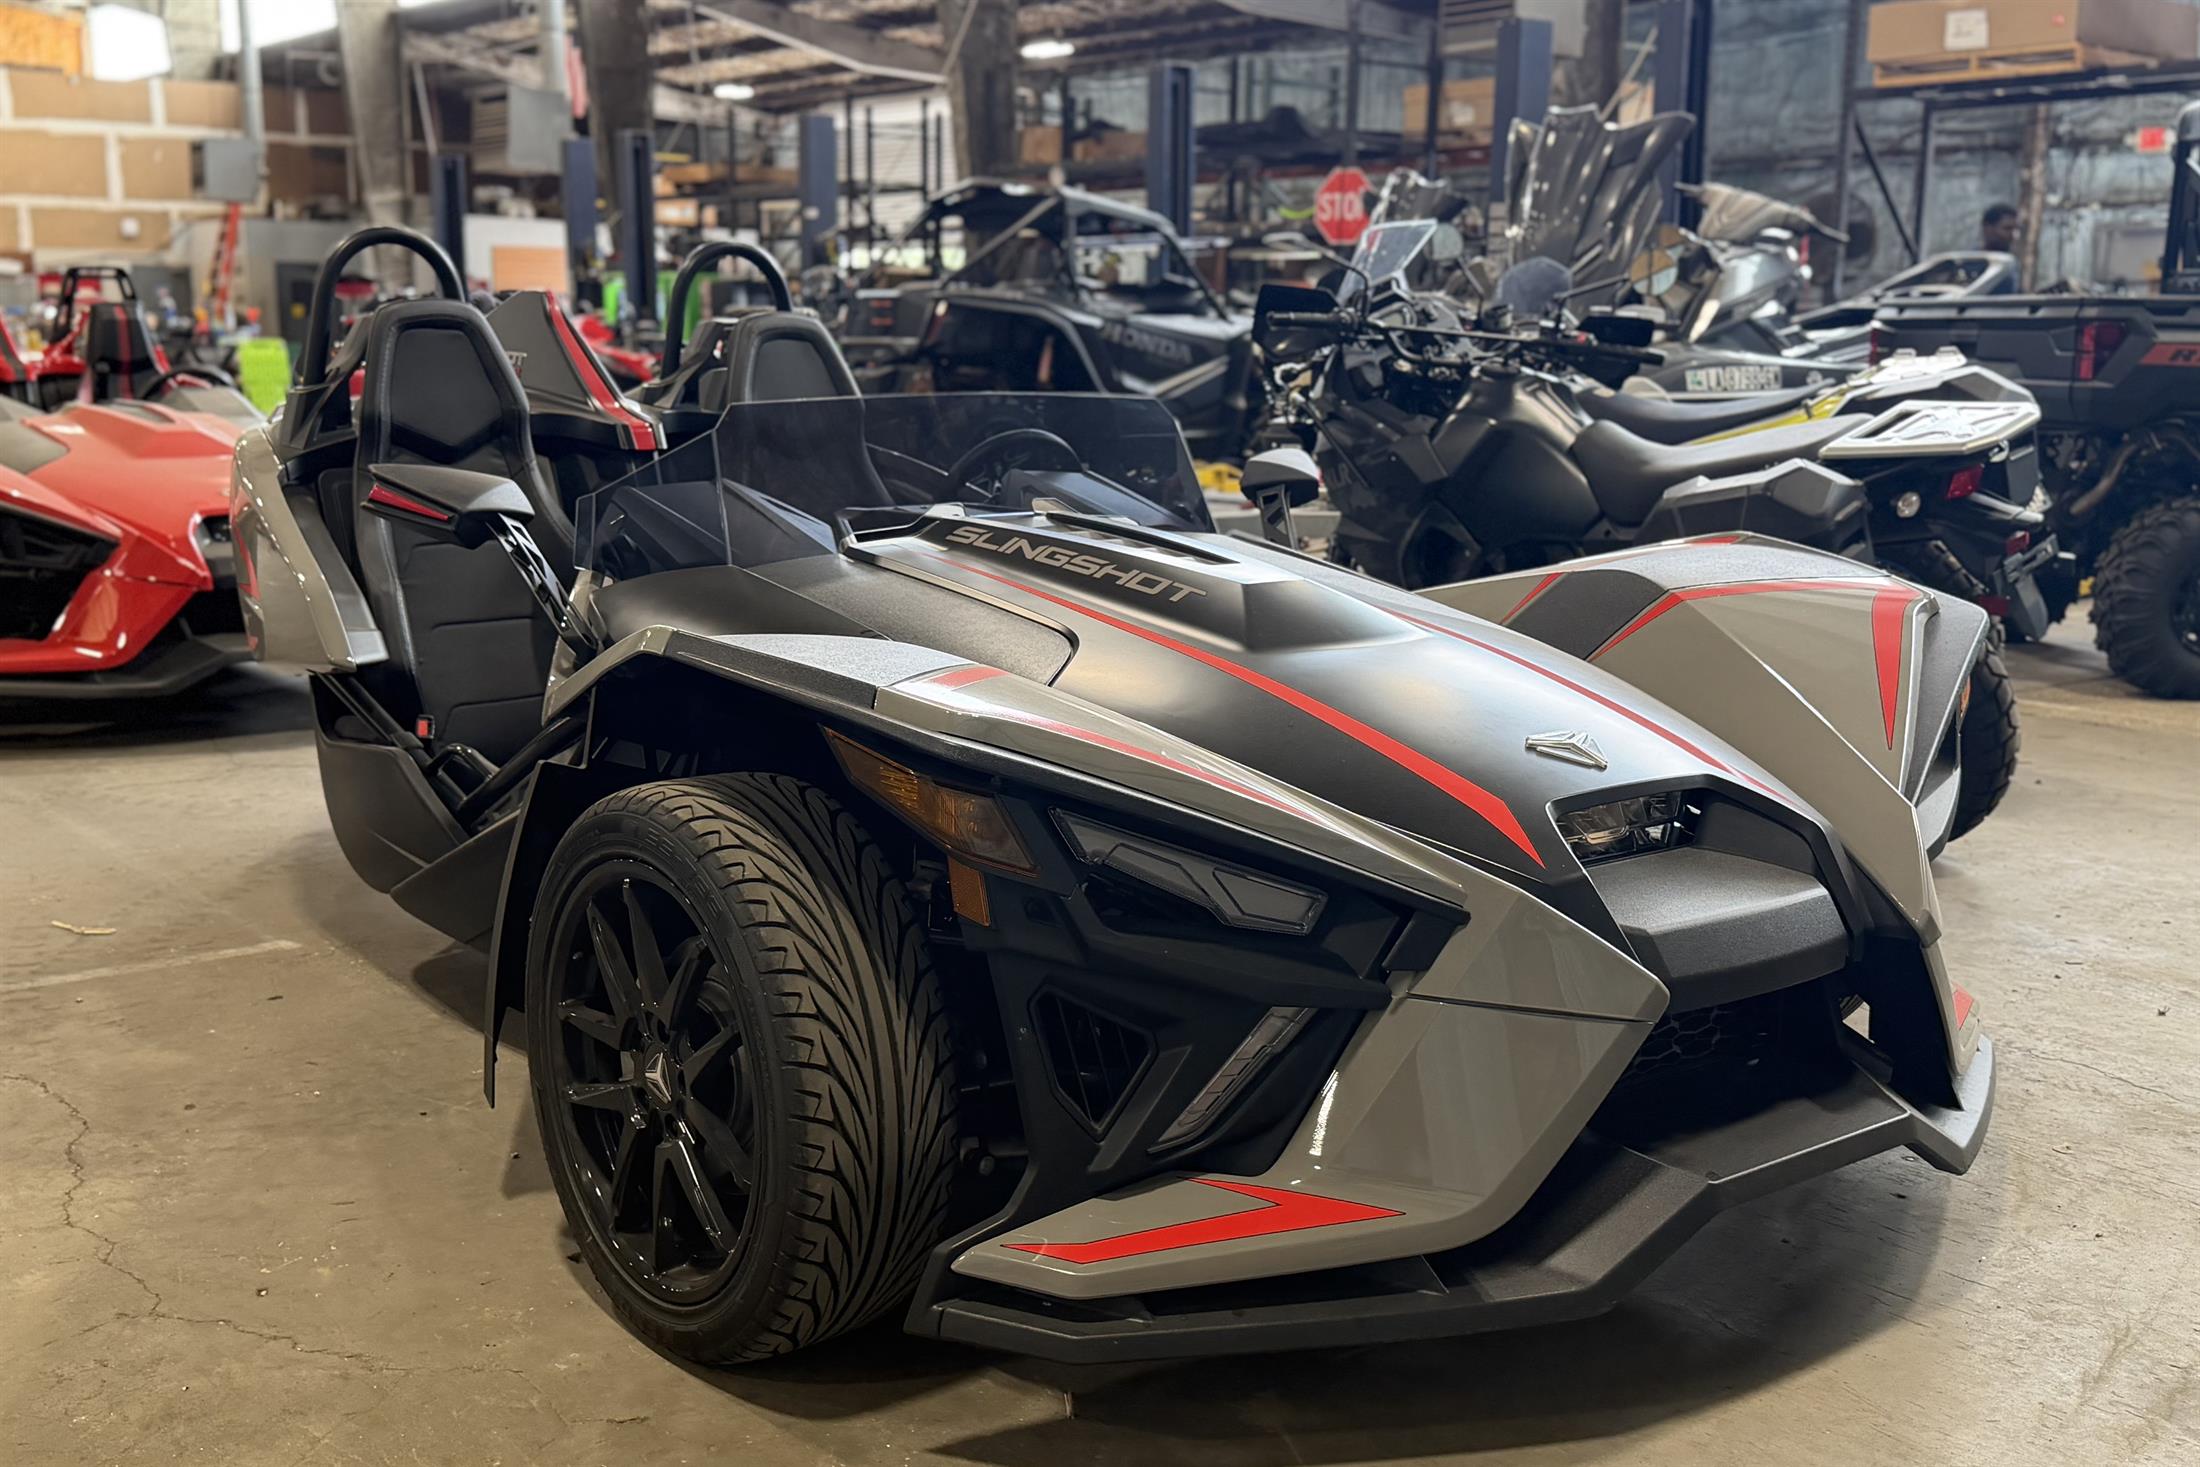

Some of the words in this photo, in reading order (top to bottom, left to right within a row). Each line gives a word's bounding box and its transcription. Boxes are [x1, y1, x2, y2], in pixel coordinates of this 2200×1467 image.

[1319, 190, 1366, 222] STO
[1099, 322, 1192, 364] HONDA
[945, 526, 1207, 603] SLINGSHOT
